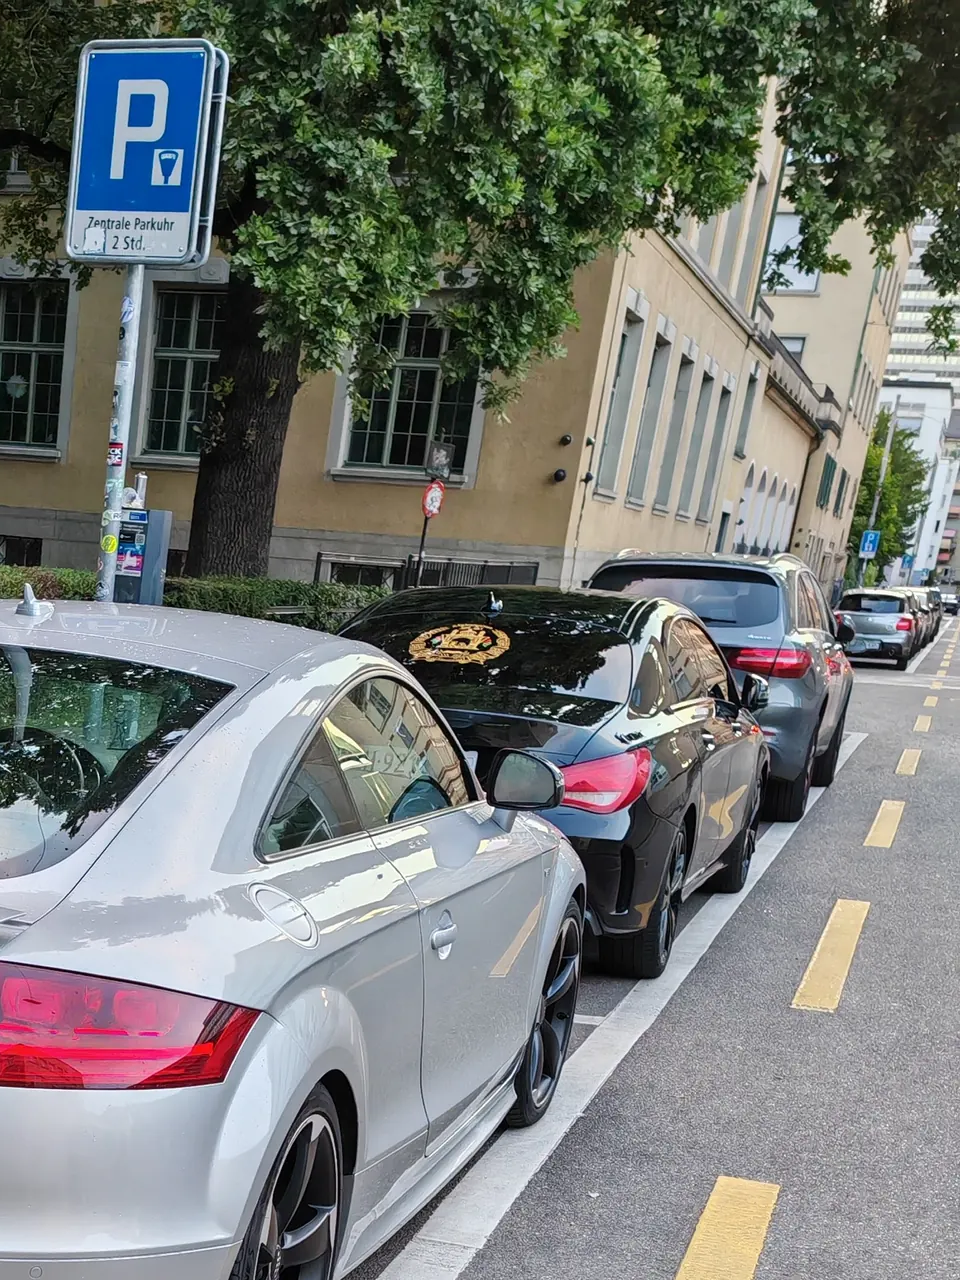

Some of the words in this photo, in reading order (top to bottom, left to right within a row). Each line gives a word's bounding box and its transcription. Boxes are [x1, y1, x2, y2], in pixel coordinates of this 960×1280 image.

[110, 79, 169, 179] P
[88, 216, 131, 230] Zentrale
[134, 218, 175, 231] Parkuhr
[112, 236, 119, 249] 2
[123, 236, 146, 250] Std.
